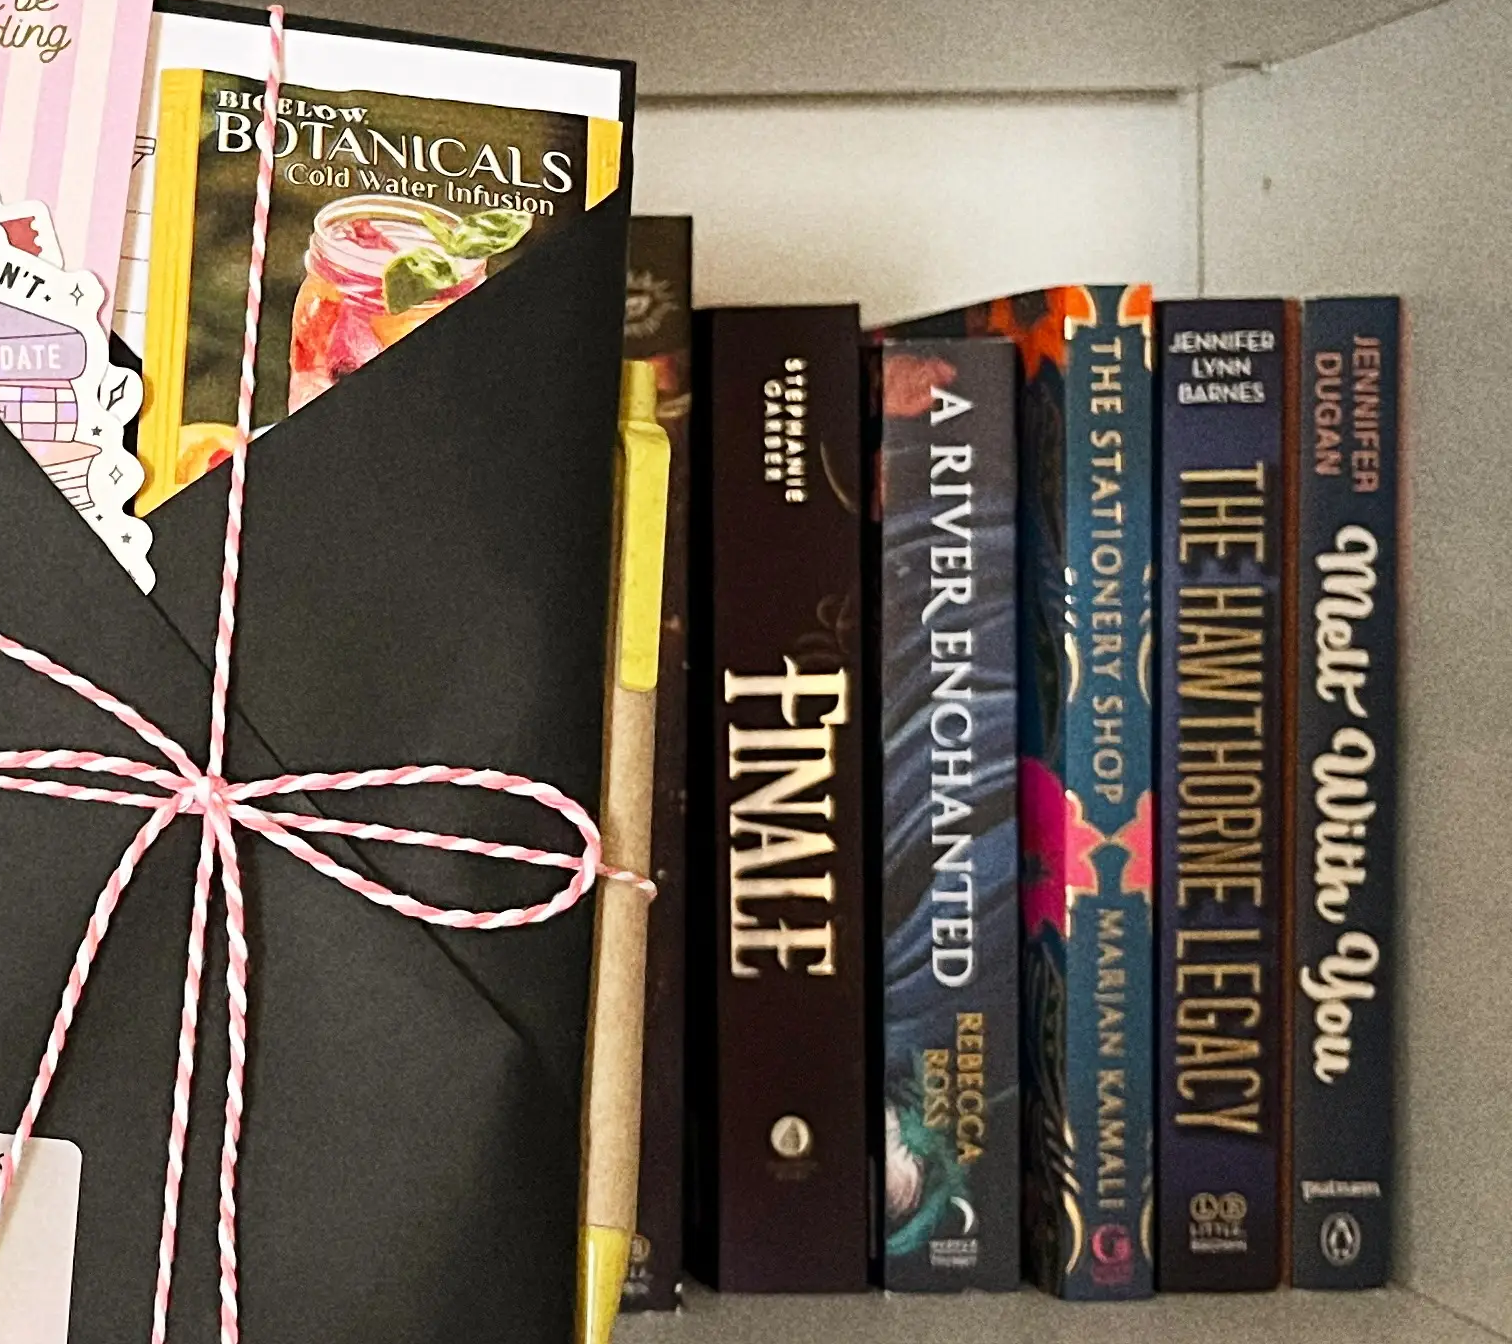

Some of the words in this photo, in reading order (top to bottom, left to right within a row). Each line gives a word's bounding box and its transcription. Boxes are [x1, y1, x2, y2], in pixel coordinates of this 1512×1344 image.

[215, 110, 574, 194] BOTANICALS
[287, 162, 351, 192] Cold
[358, 169, 438, 201] Water
[446, 180, 555, 219] Infusion
[1091, 336, 1122, 416] THE
[1177, 382, 1266, 406] BARNES
[1191, 356, 1252, 378] LYNN
[1313, 352, 1344, 477] DUGAN
[1350, 335, 1382, 494] JENNIFER
[921, 444, 974, 626] RIVER
[1090, 429, 1124, 683] STATIONERY
[1178, 460, 1265, 564] THE
[929, 629, 975, 989] ENCHANTED
[1092, 693, 1125, 804] SHOP
[1177, 586, 1265, 907] HAWTHORNE
[724, 654, 849, 979] FINALE
[1175, 929, 1263, 1135] LEGACY
